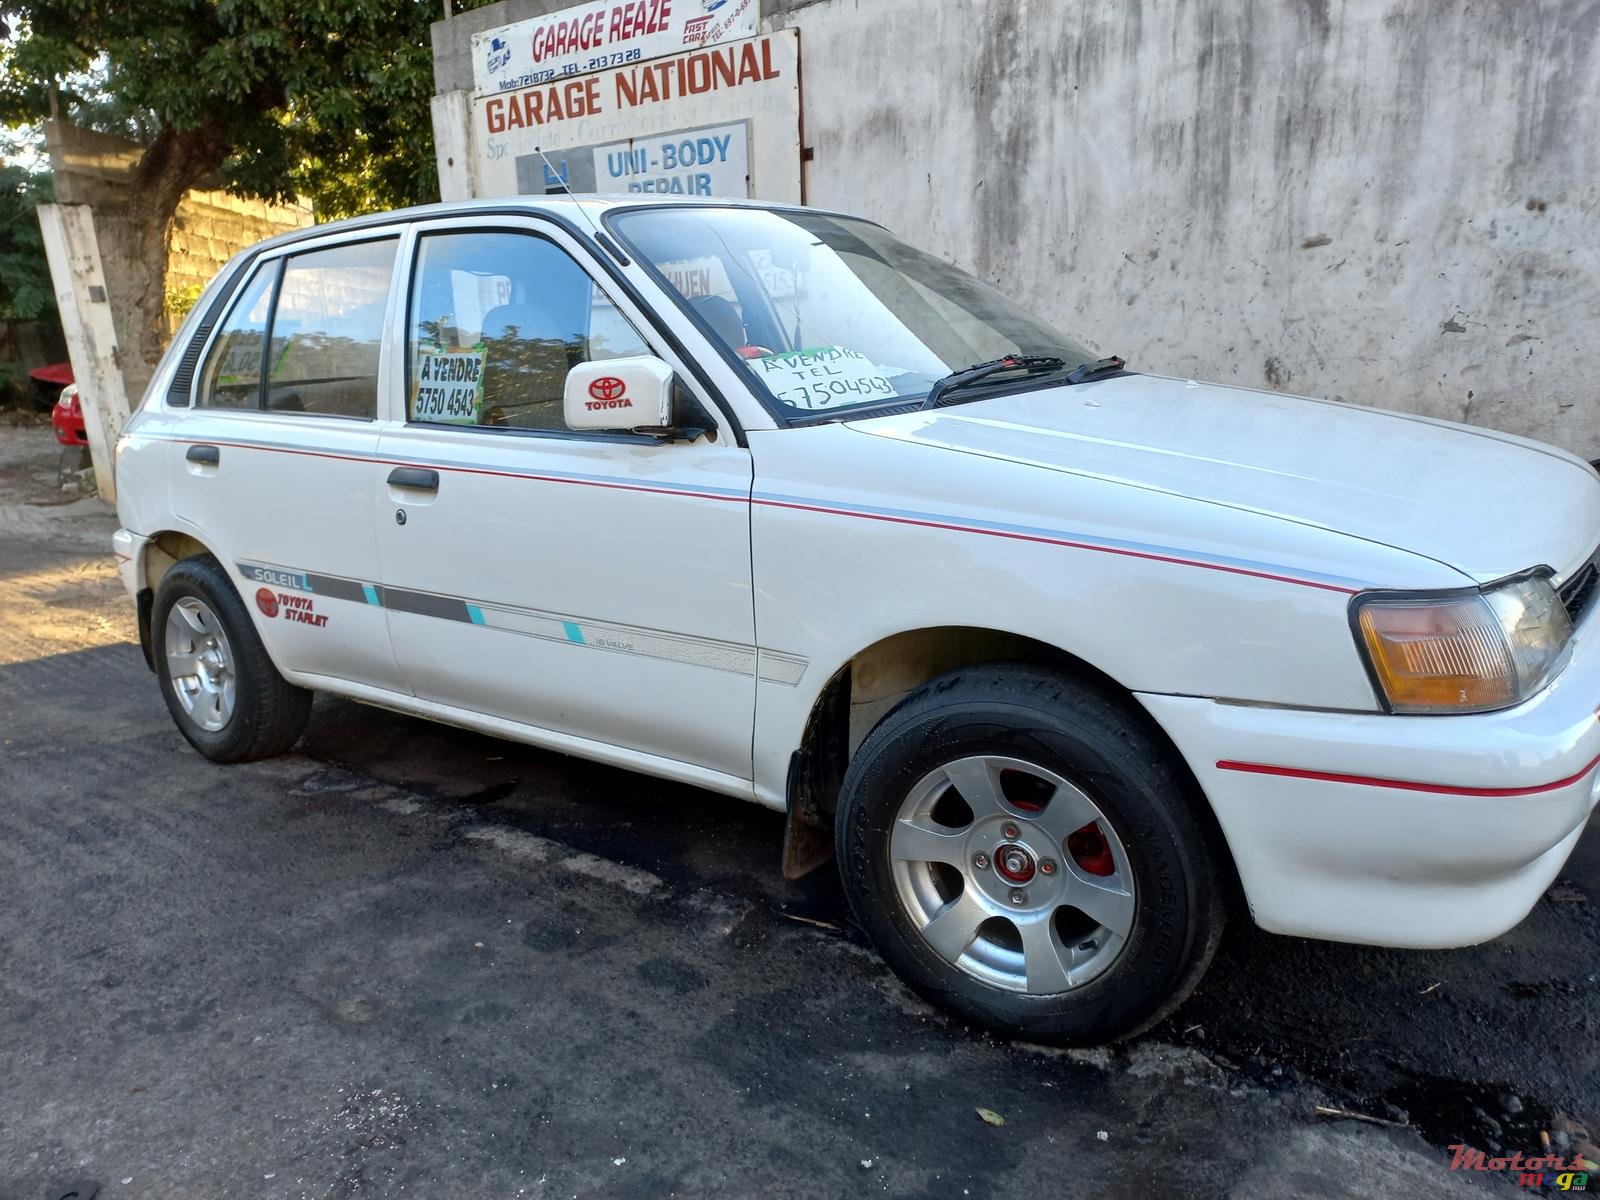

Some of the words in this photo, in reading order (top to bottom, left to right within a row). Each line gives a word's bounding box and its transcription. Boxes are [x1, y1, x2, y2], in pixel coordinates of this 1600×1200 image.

[532, 10, 606, 63] GARAGE
[609, 0, 672, 43] REAZE
[684, 17, 711, 34] FAST
[590, 55, 608, 70] 213
[610, 53, 623, 66] 73
[625, 48, 641, 61] 28
[486, 76, 603, 134] GARAGE
[616, 38, 780, 110] NATIONAL
[784, 347, 863, 369] VENDRE
[421, 356, 431, 380] A
[434, 357, 482, 383] VENDRE
[792, 365, 843, 381] TEL
[416, 387, 445, 415] 5750
[447, 388, 475, 417] 4543
[585, 398, 633, 411] TOYOTA
[254, 568, 301, 589] SOLEIL
[277, 593, 314, 612] TOYOTA
[285, 609, 329, 627] STARLET
[606, 640, 634, 650] VALVE
